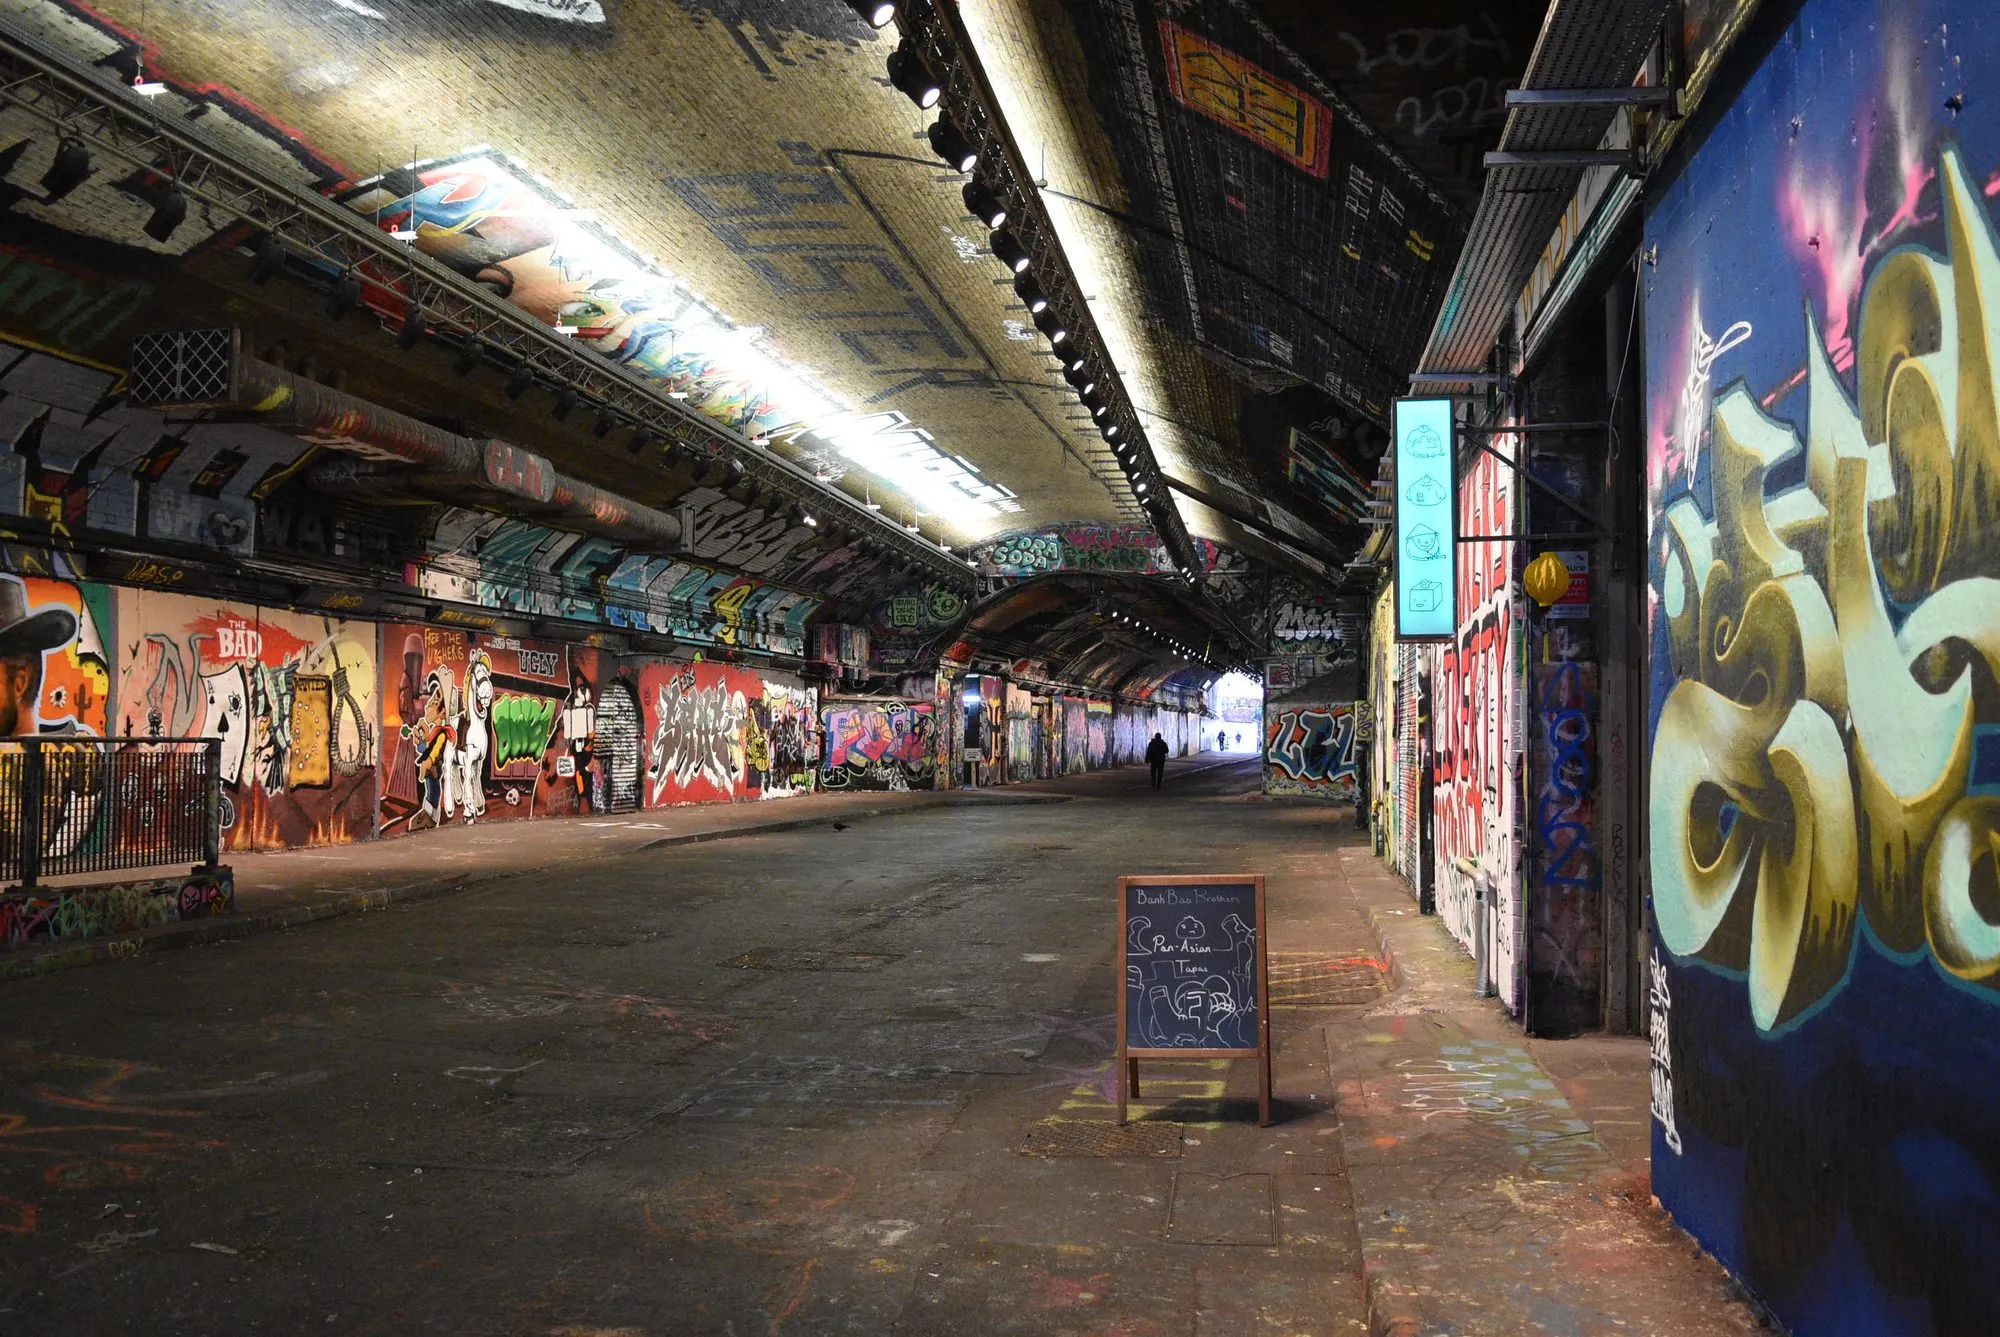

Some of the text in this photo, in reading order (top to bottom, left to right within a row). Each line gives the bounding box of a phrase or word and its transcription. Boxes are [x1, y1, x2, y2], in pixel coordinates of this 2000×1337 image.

[993, 546, 1047, 569] SODA
[229, 618, 247, 630] THE
[216, 627, 263, 659] BAD
[442, 631, 462, 645] THE
[518, 648, 558, 678] UGLY
[1433, 599, 1510, 817] LIBERTY
[1167, 888, 1192, 905] Bao
[1152, 934, 1213, 955] Pan-Asian
[1175, 959, 1210, 975] Tapas
